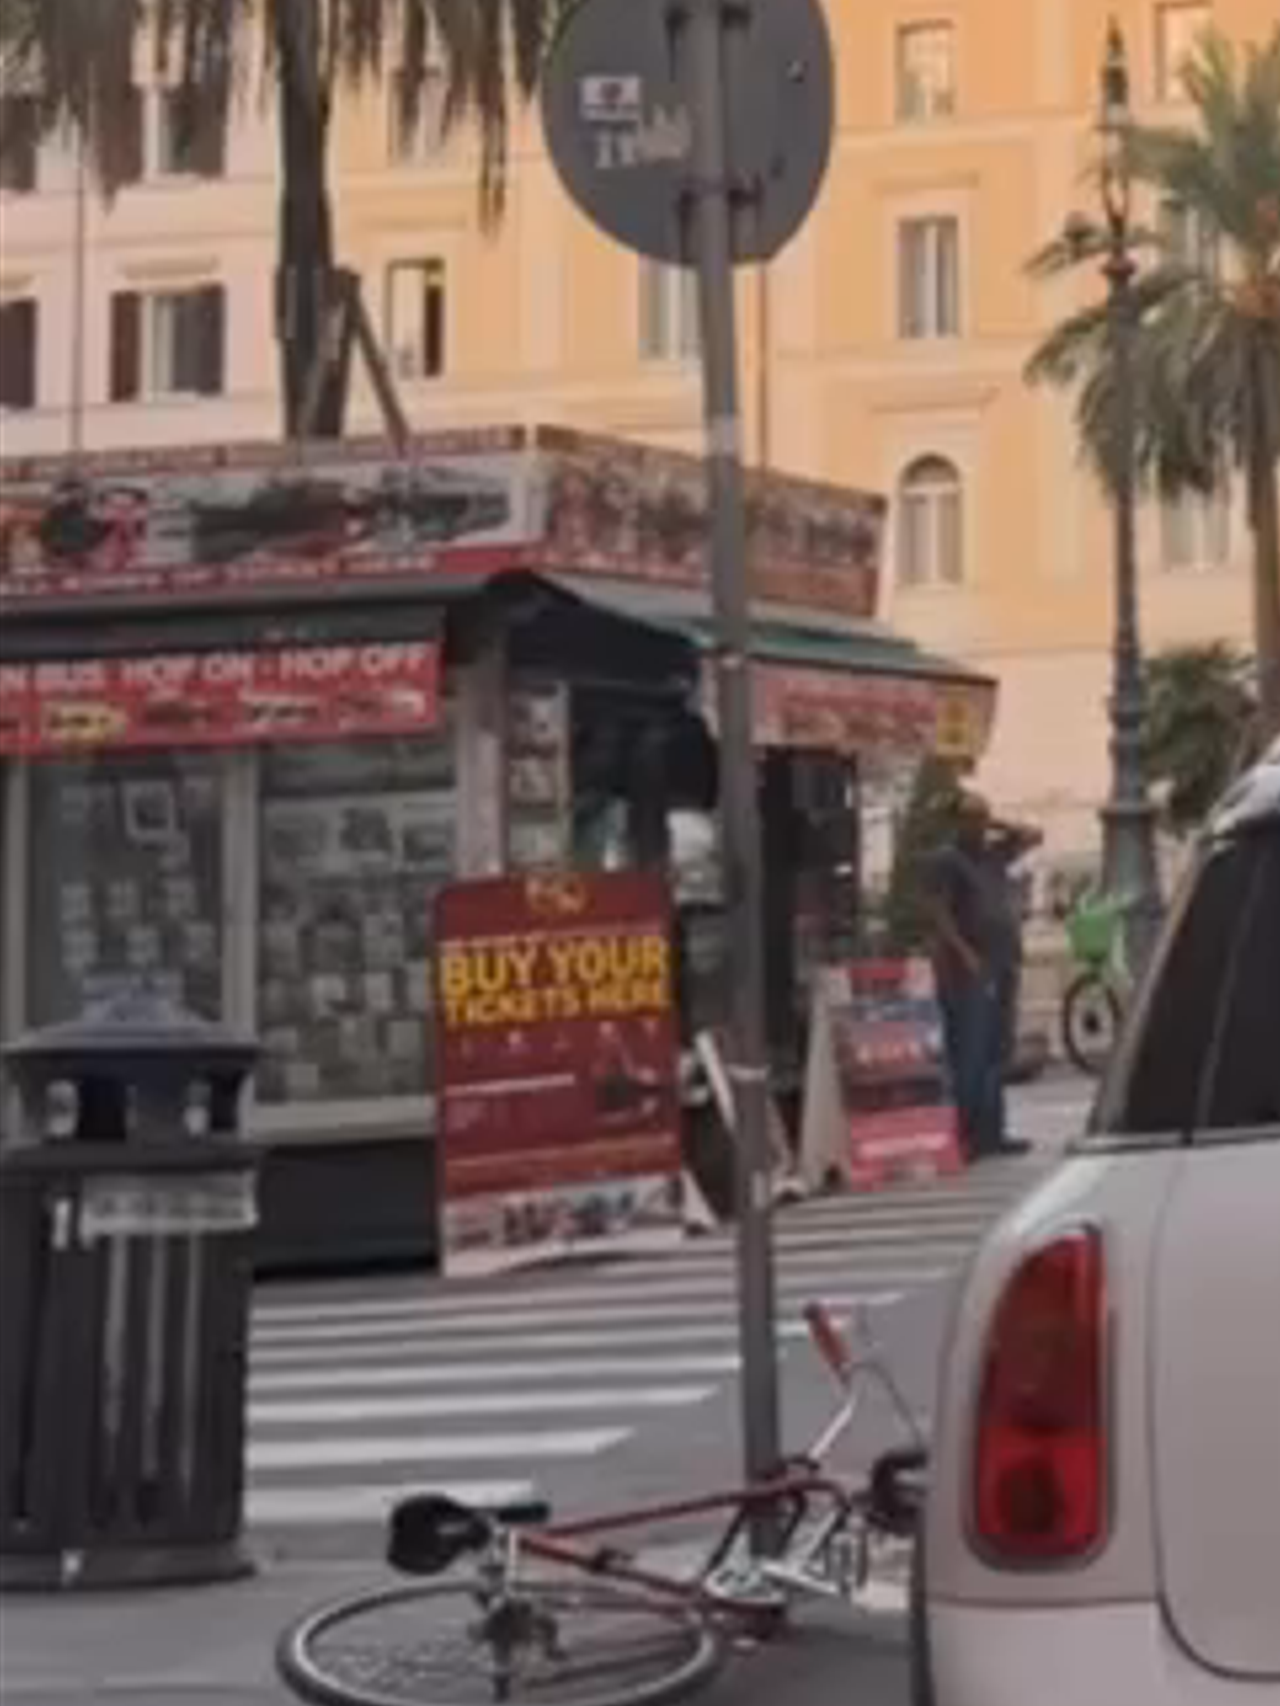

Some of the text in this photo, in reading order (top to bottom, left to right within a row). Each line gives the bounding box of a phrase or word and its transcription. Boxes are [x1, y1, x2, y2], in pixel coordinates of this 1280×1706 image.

[35, 660, 105, 692] BUS
[120, 654, 197, 687] HOP
[202, 652, 256, 683] ON
[280, 647, 355, 681] HOP
[360, 642, 429, 675] OFF
[442, 934, 668, 995] BUY YOUR
[446, 980, 668, 1027] TICKETS HERE
